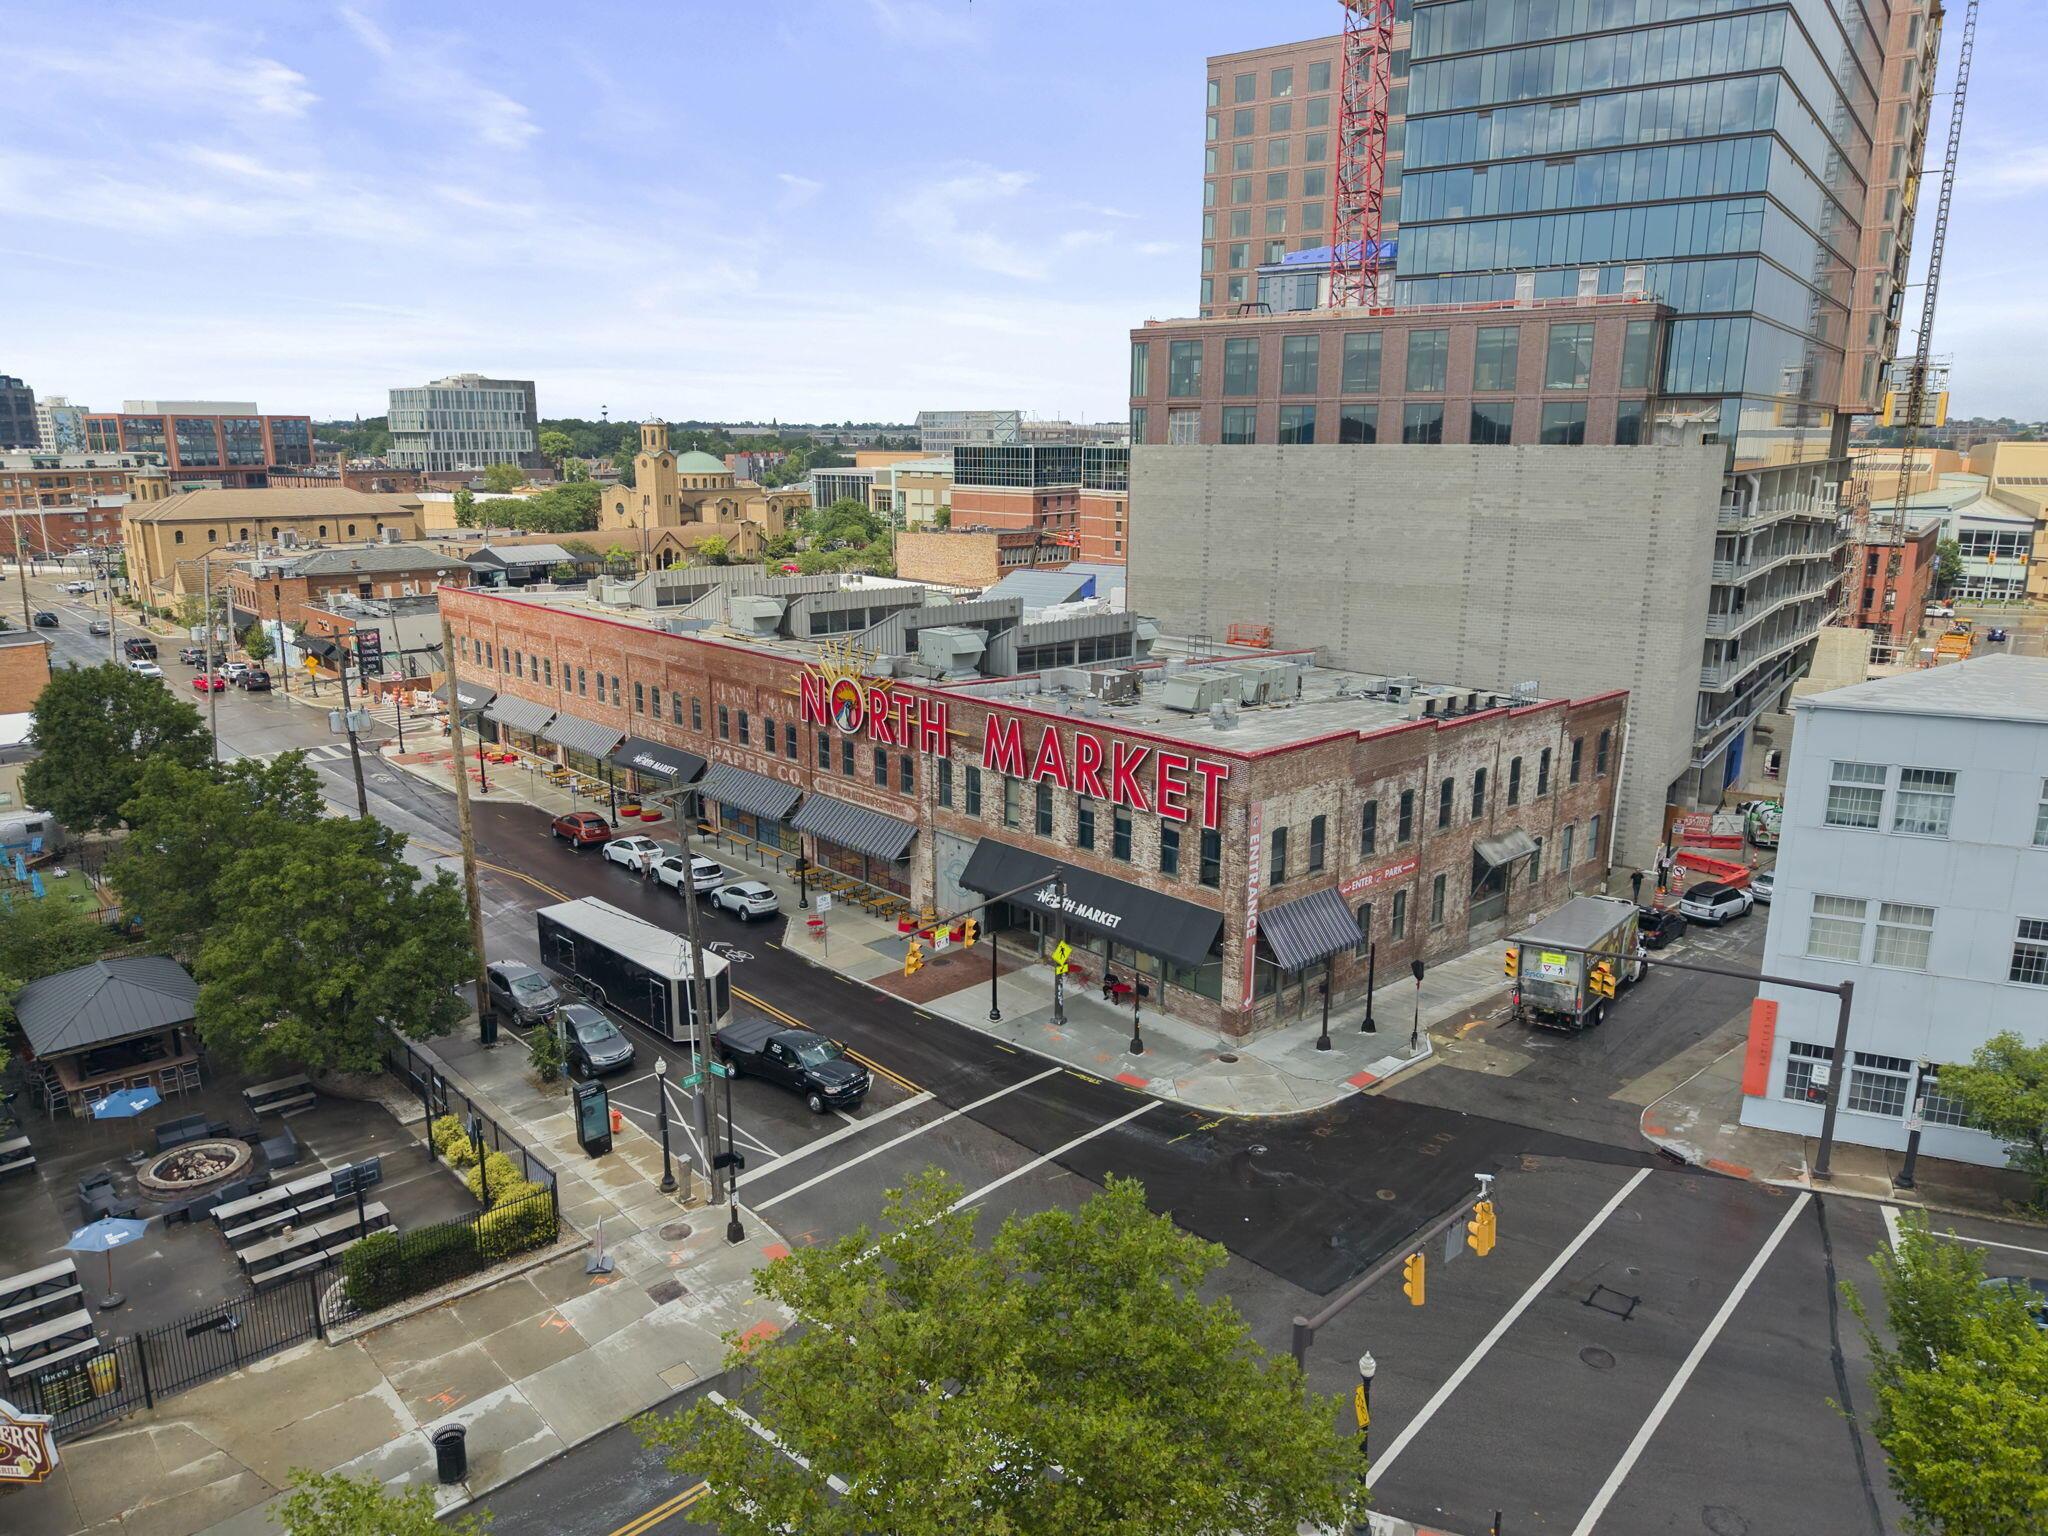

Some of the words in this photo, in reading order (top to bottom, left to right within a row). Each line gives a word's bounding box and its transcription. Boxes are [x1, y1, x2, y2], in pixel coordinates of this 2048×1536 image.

[710, 745, 769, 776] PAPER
[799, 671, 947, 758] NORTH
[982, 712, 1229, 830] MARKET
[1246, 834, 1260, 938] ENTRANCE
[1351, 875, 1373, 890] ENTER
[1384, 865, 1403, 878] PARK
[1075, 904, 1122, 928] MARKET
